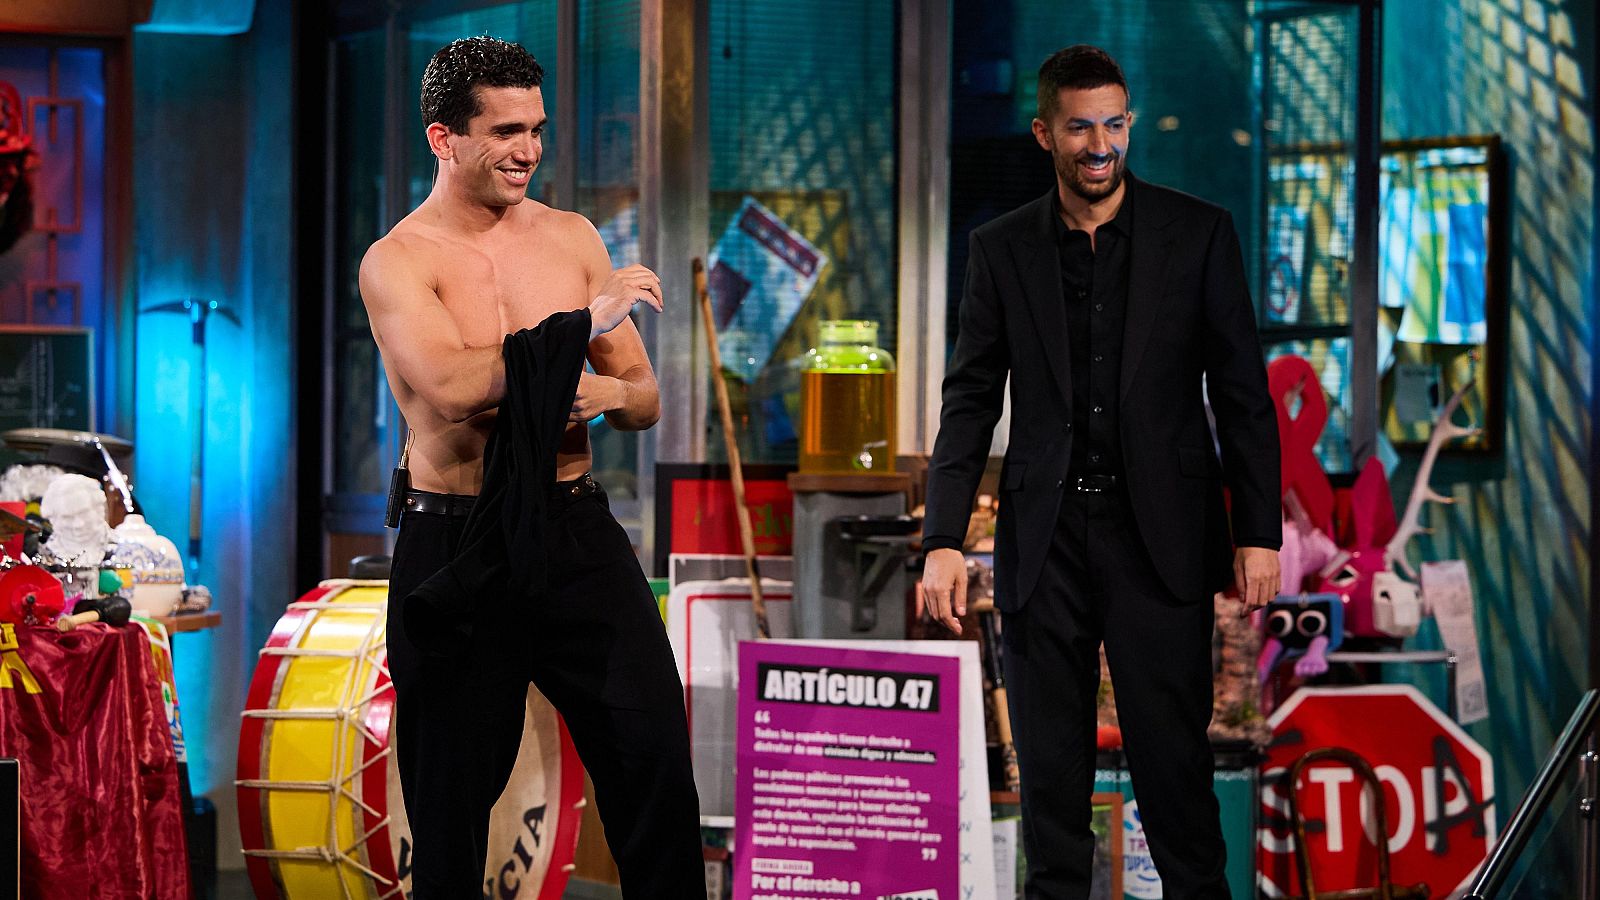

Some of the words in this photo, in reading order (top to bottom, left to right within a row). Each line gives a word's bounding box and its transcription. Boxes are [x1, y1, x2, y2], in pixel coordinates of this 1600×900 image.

[764, 668, 897, 707] ARTÍCULO
[900, 679, 933, 709] 47
[1258, 765, 1470, 854] STOP
[752, 873, 776, 890] Por
[776, 875, 792, 891] el
[792, 875, 849, 894] derecho
[850, 881, 861, 895] a
